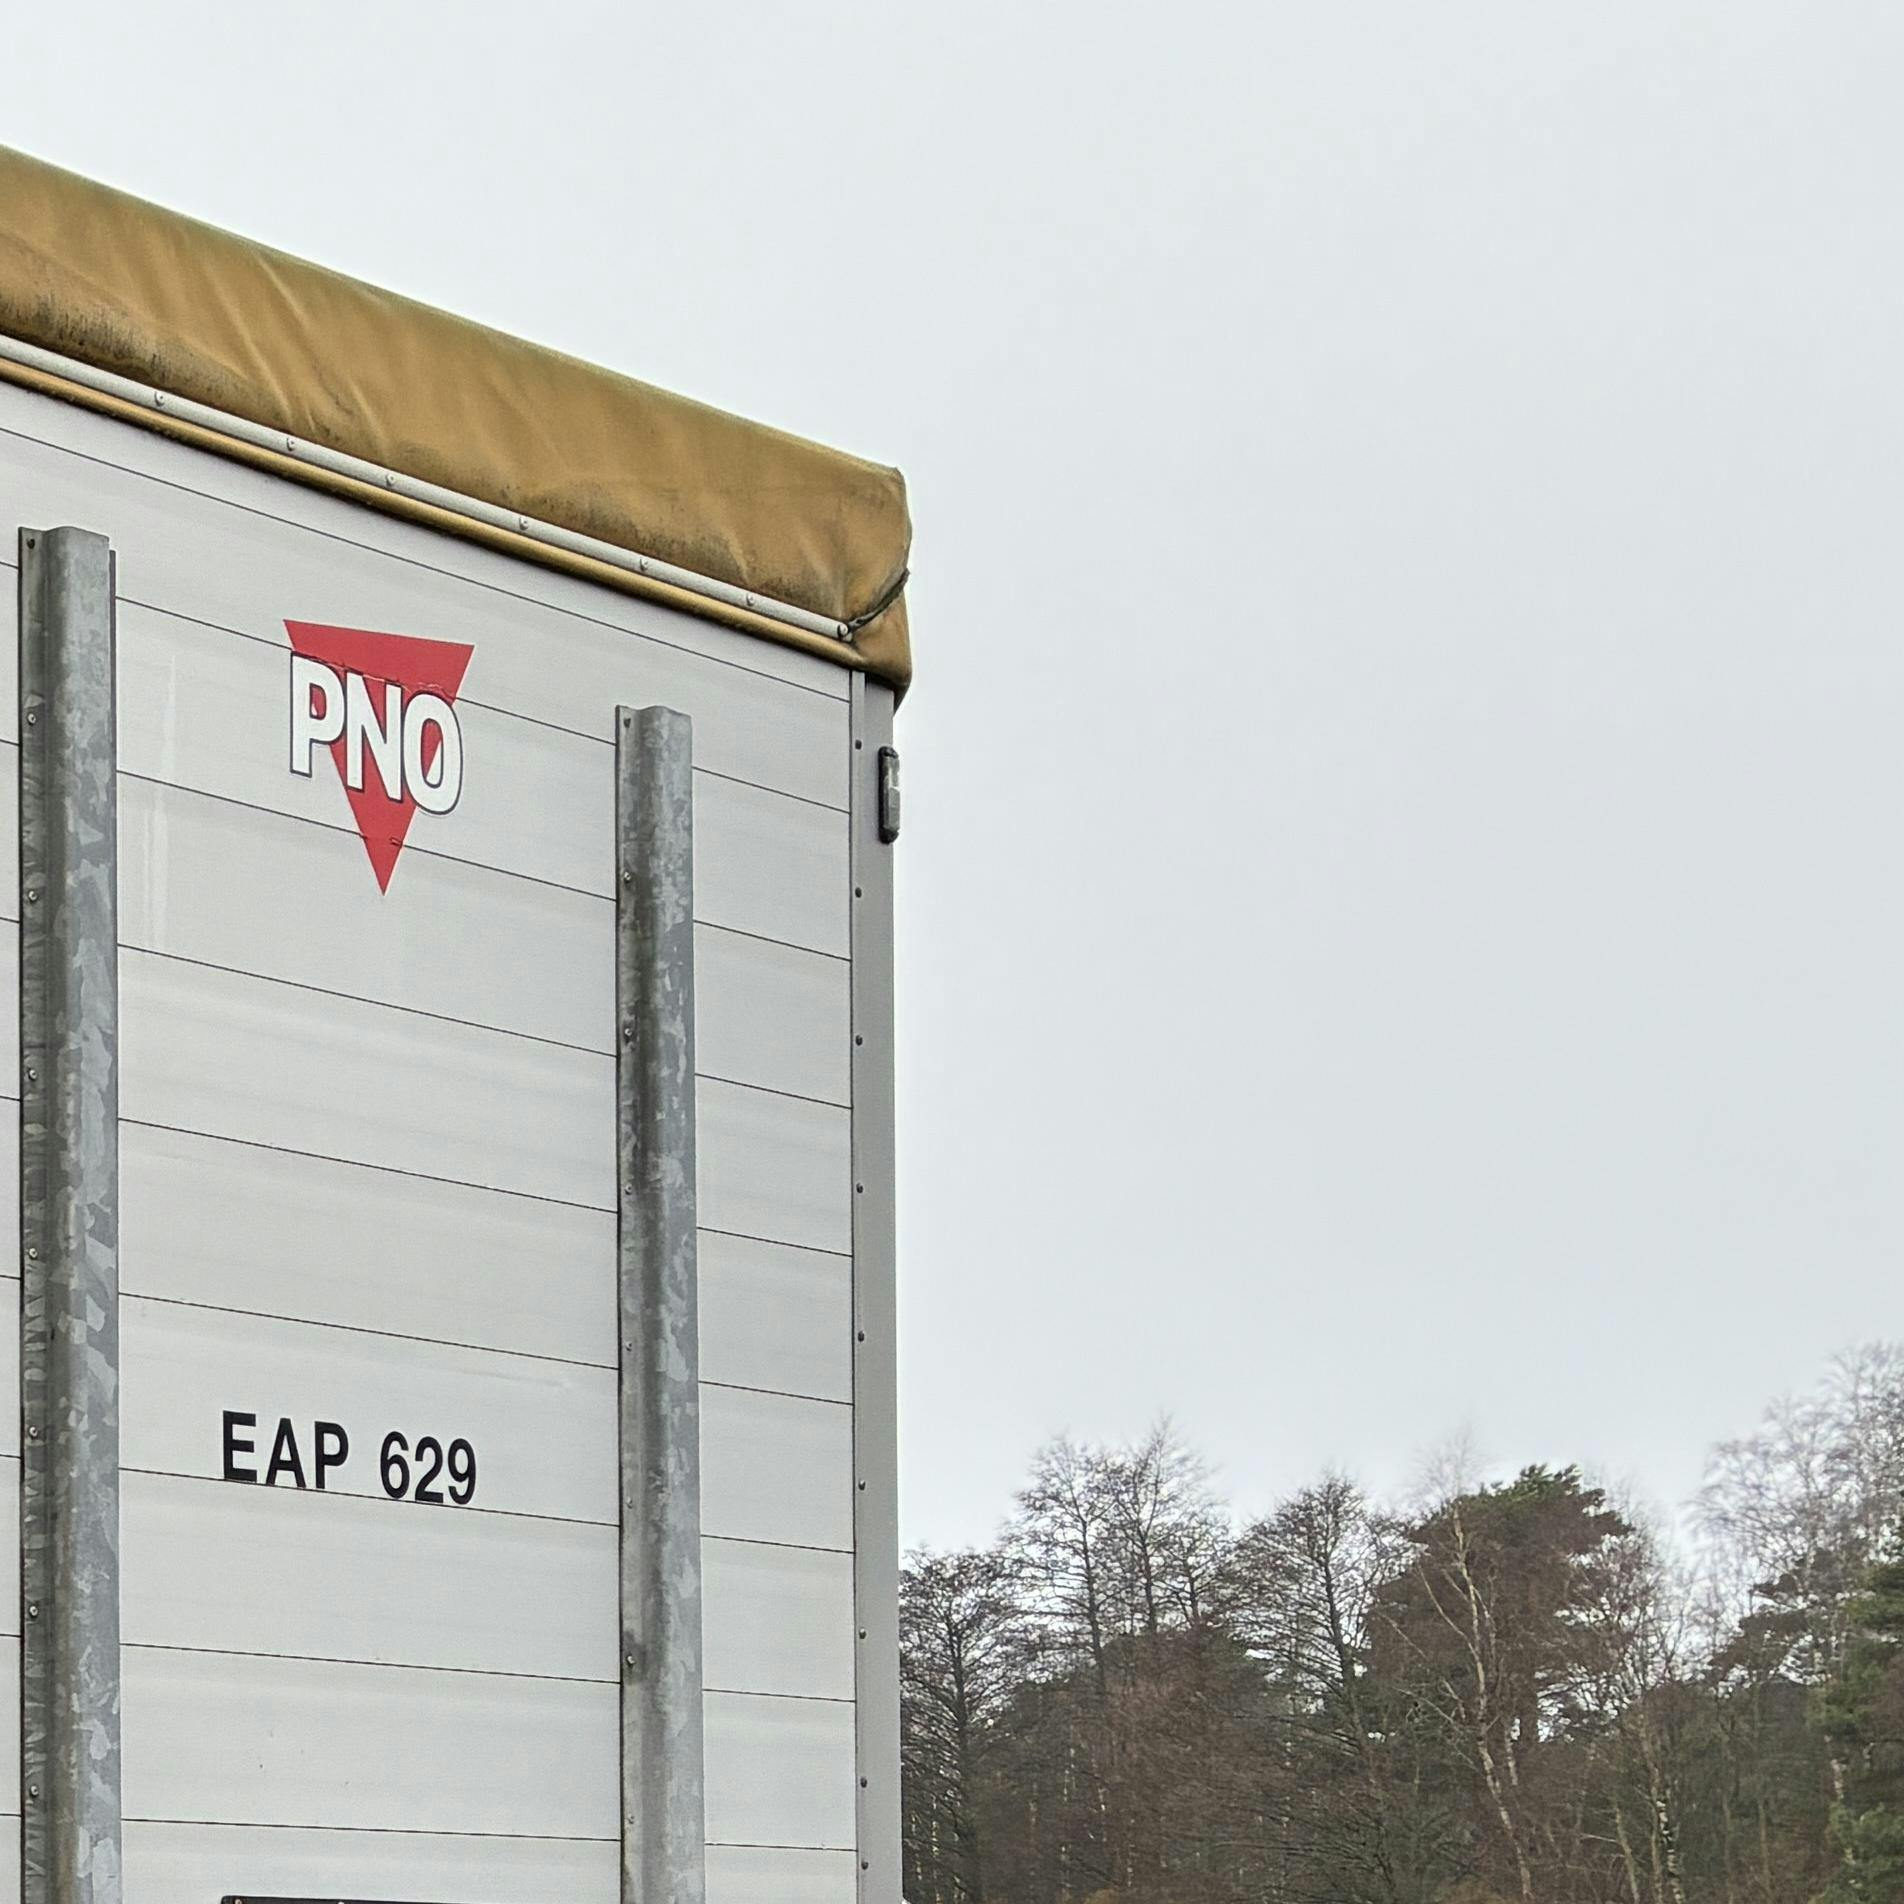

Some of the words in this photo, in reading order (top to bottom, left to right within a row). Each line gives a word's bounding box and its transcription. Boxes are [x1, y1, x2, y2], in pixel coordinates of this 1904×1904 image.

[290, 651, 463, 815] PNO
[223, 1410, 349, 1490] EAP
[380, 1431, 476, 1505] 629
